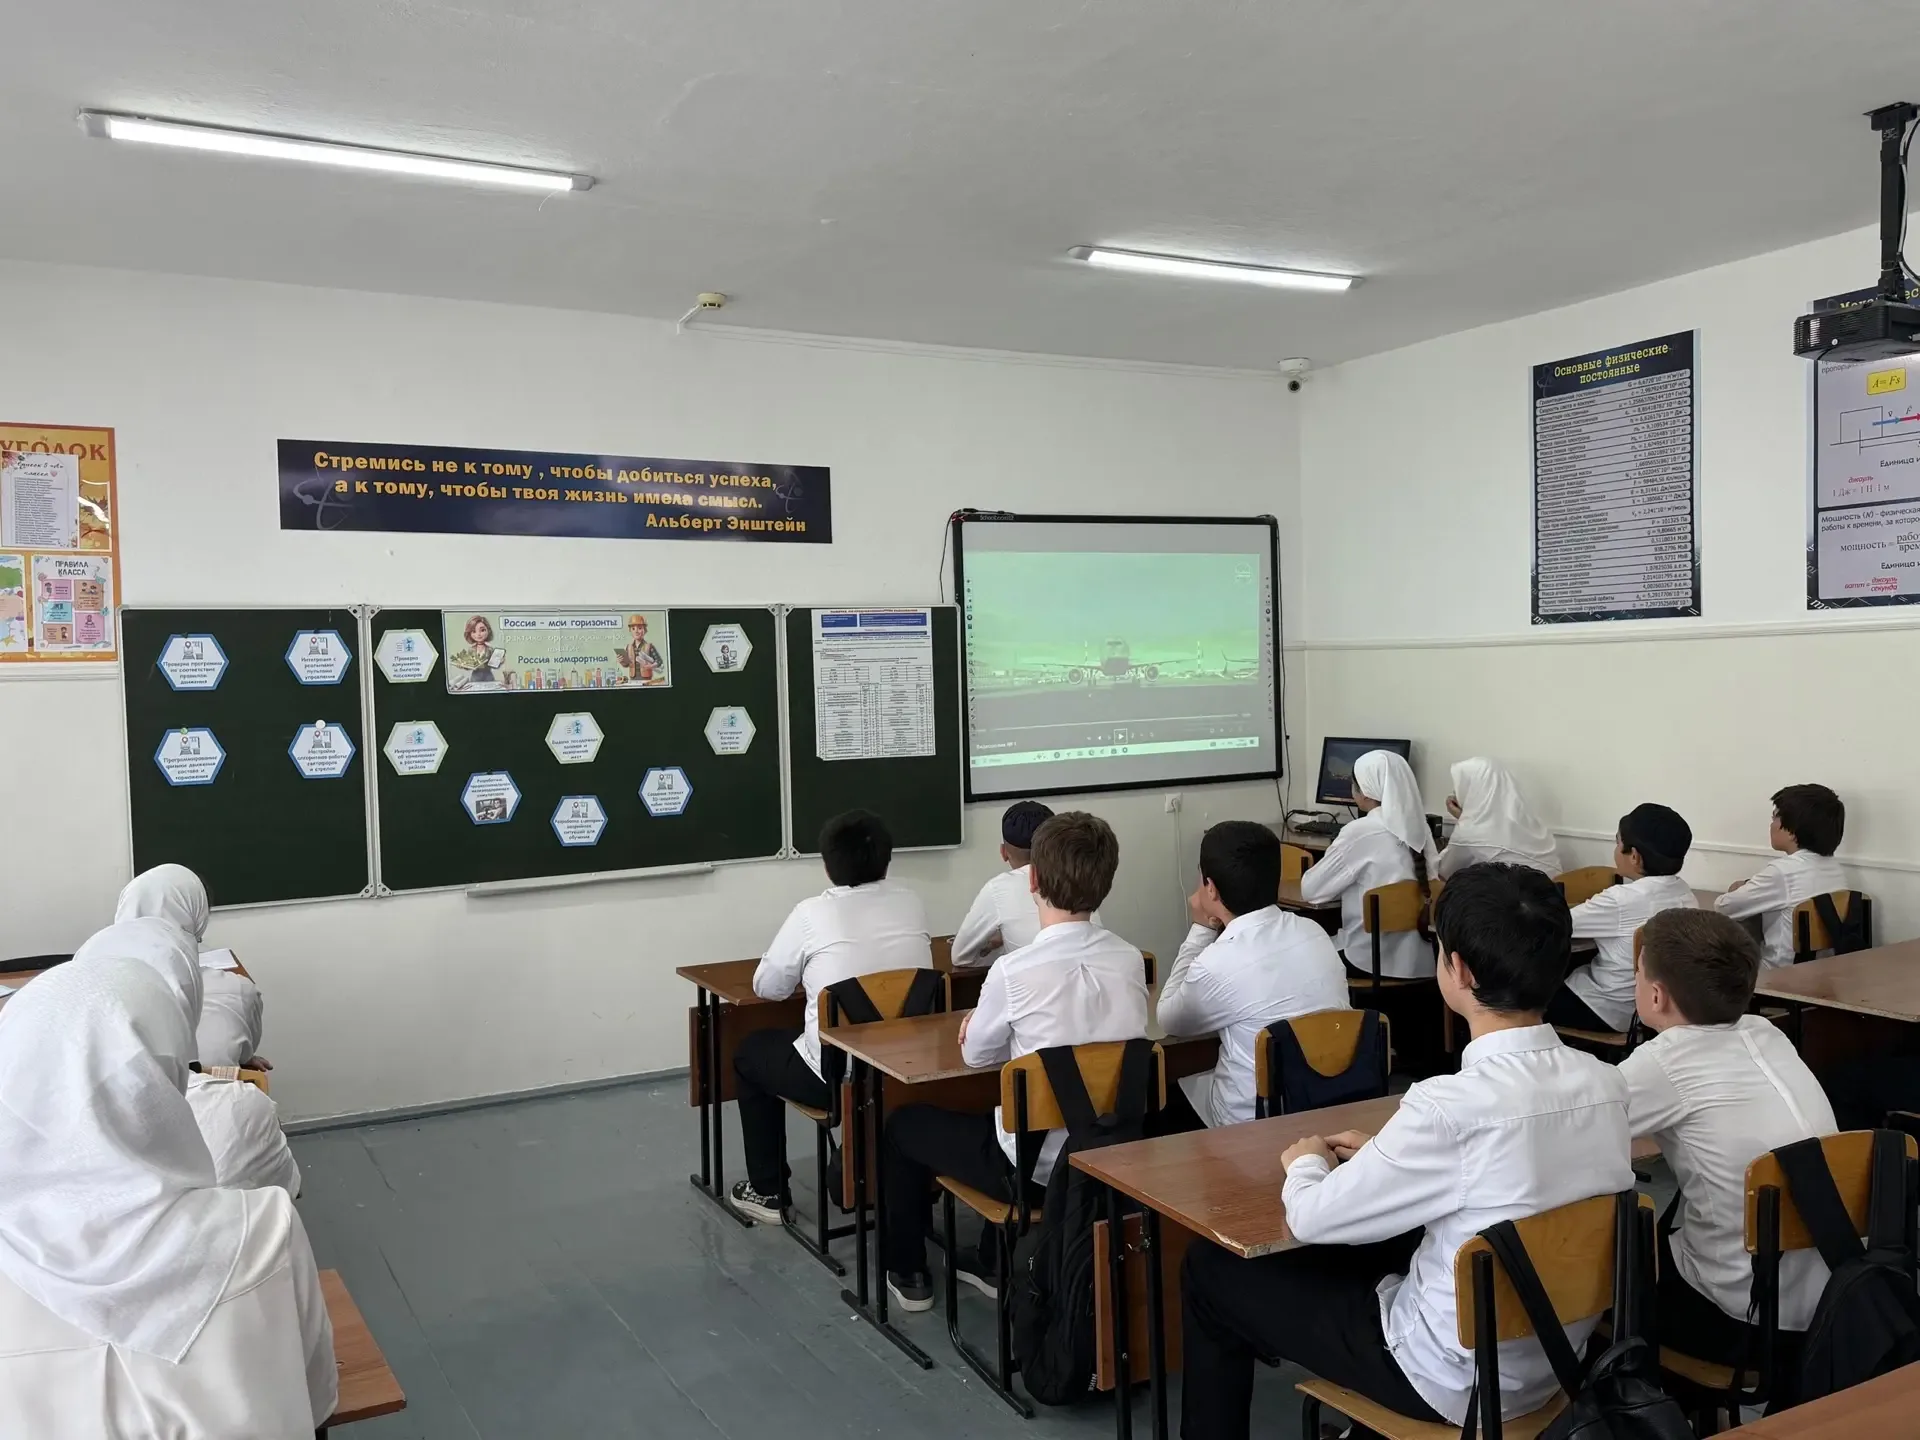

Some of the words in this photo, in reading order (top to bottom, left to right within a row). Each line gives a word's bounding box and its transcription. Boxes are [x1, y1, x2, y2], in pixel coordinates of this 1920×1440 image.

[1554, 358, 1602, 377] Основные
[1605, 343, 1668, 367] физические
[1579, 363, 1640, 384] постоянные
[1880, 457, 1914, 468] Единица
[314, 451, 426, 472] Стремись
[432, 460, 458, 473] не
[464, 461, 477, 474] к
[482, 462, 532, 480] тому
[550, 464, 613, 481] чтобы
[617, 467, 704, 485] добиться
[710, 472, 777, 490] успеха,
[335, 479, 348, 493] а
[355, 480, 368, 493] к
[374, 481, 434, 499] тому,
[440, 481, 507, 499] чтобы
[512, 486, 559, 500] твоя
[565, 488, 628, 503] жизнь
[634, 492, 693, 506] имела
[698, 494, 763, 509] смысл.
[1821, 514, 1861, 523] Мощность
[1863, 511, 1874, 519] (N)
[1880, 507, 1920, 518] физическая
[646, 513, 722, 531] Альберт
[727, 516, 806, 532] Энштейн
[1821, 522, 1845, 532] работы
[1852, 520, 1883, 530] времени,
[1840, 541, 1887, 552] мощность
[55, 560, 89, 568] ПРАВИЛА
[1881, 561, 1915, 570] Единица
[504, 618, 536, 628] Россия
[548, 619, 567, 627] мои
[571, 618, 618, 629] горизонты
[518, 655, 550, 664] Россия
[554, 655, 608, 665] комфортная
[163, 755, 217, 763] Программирование
